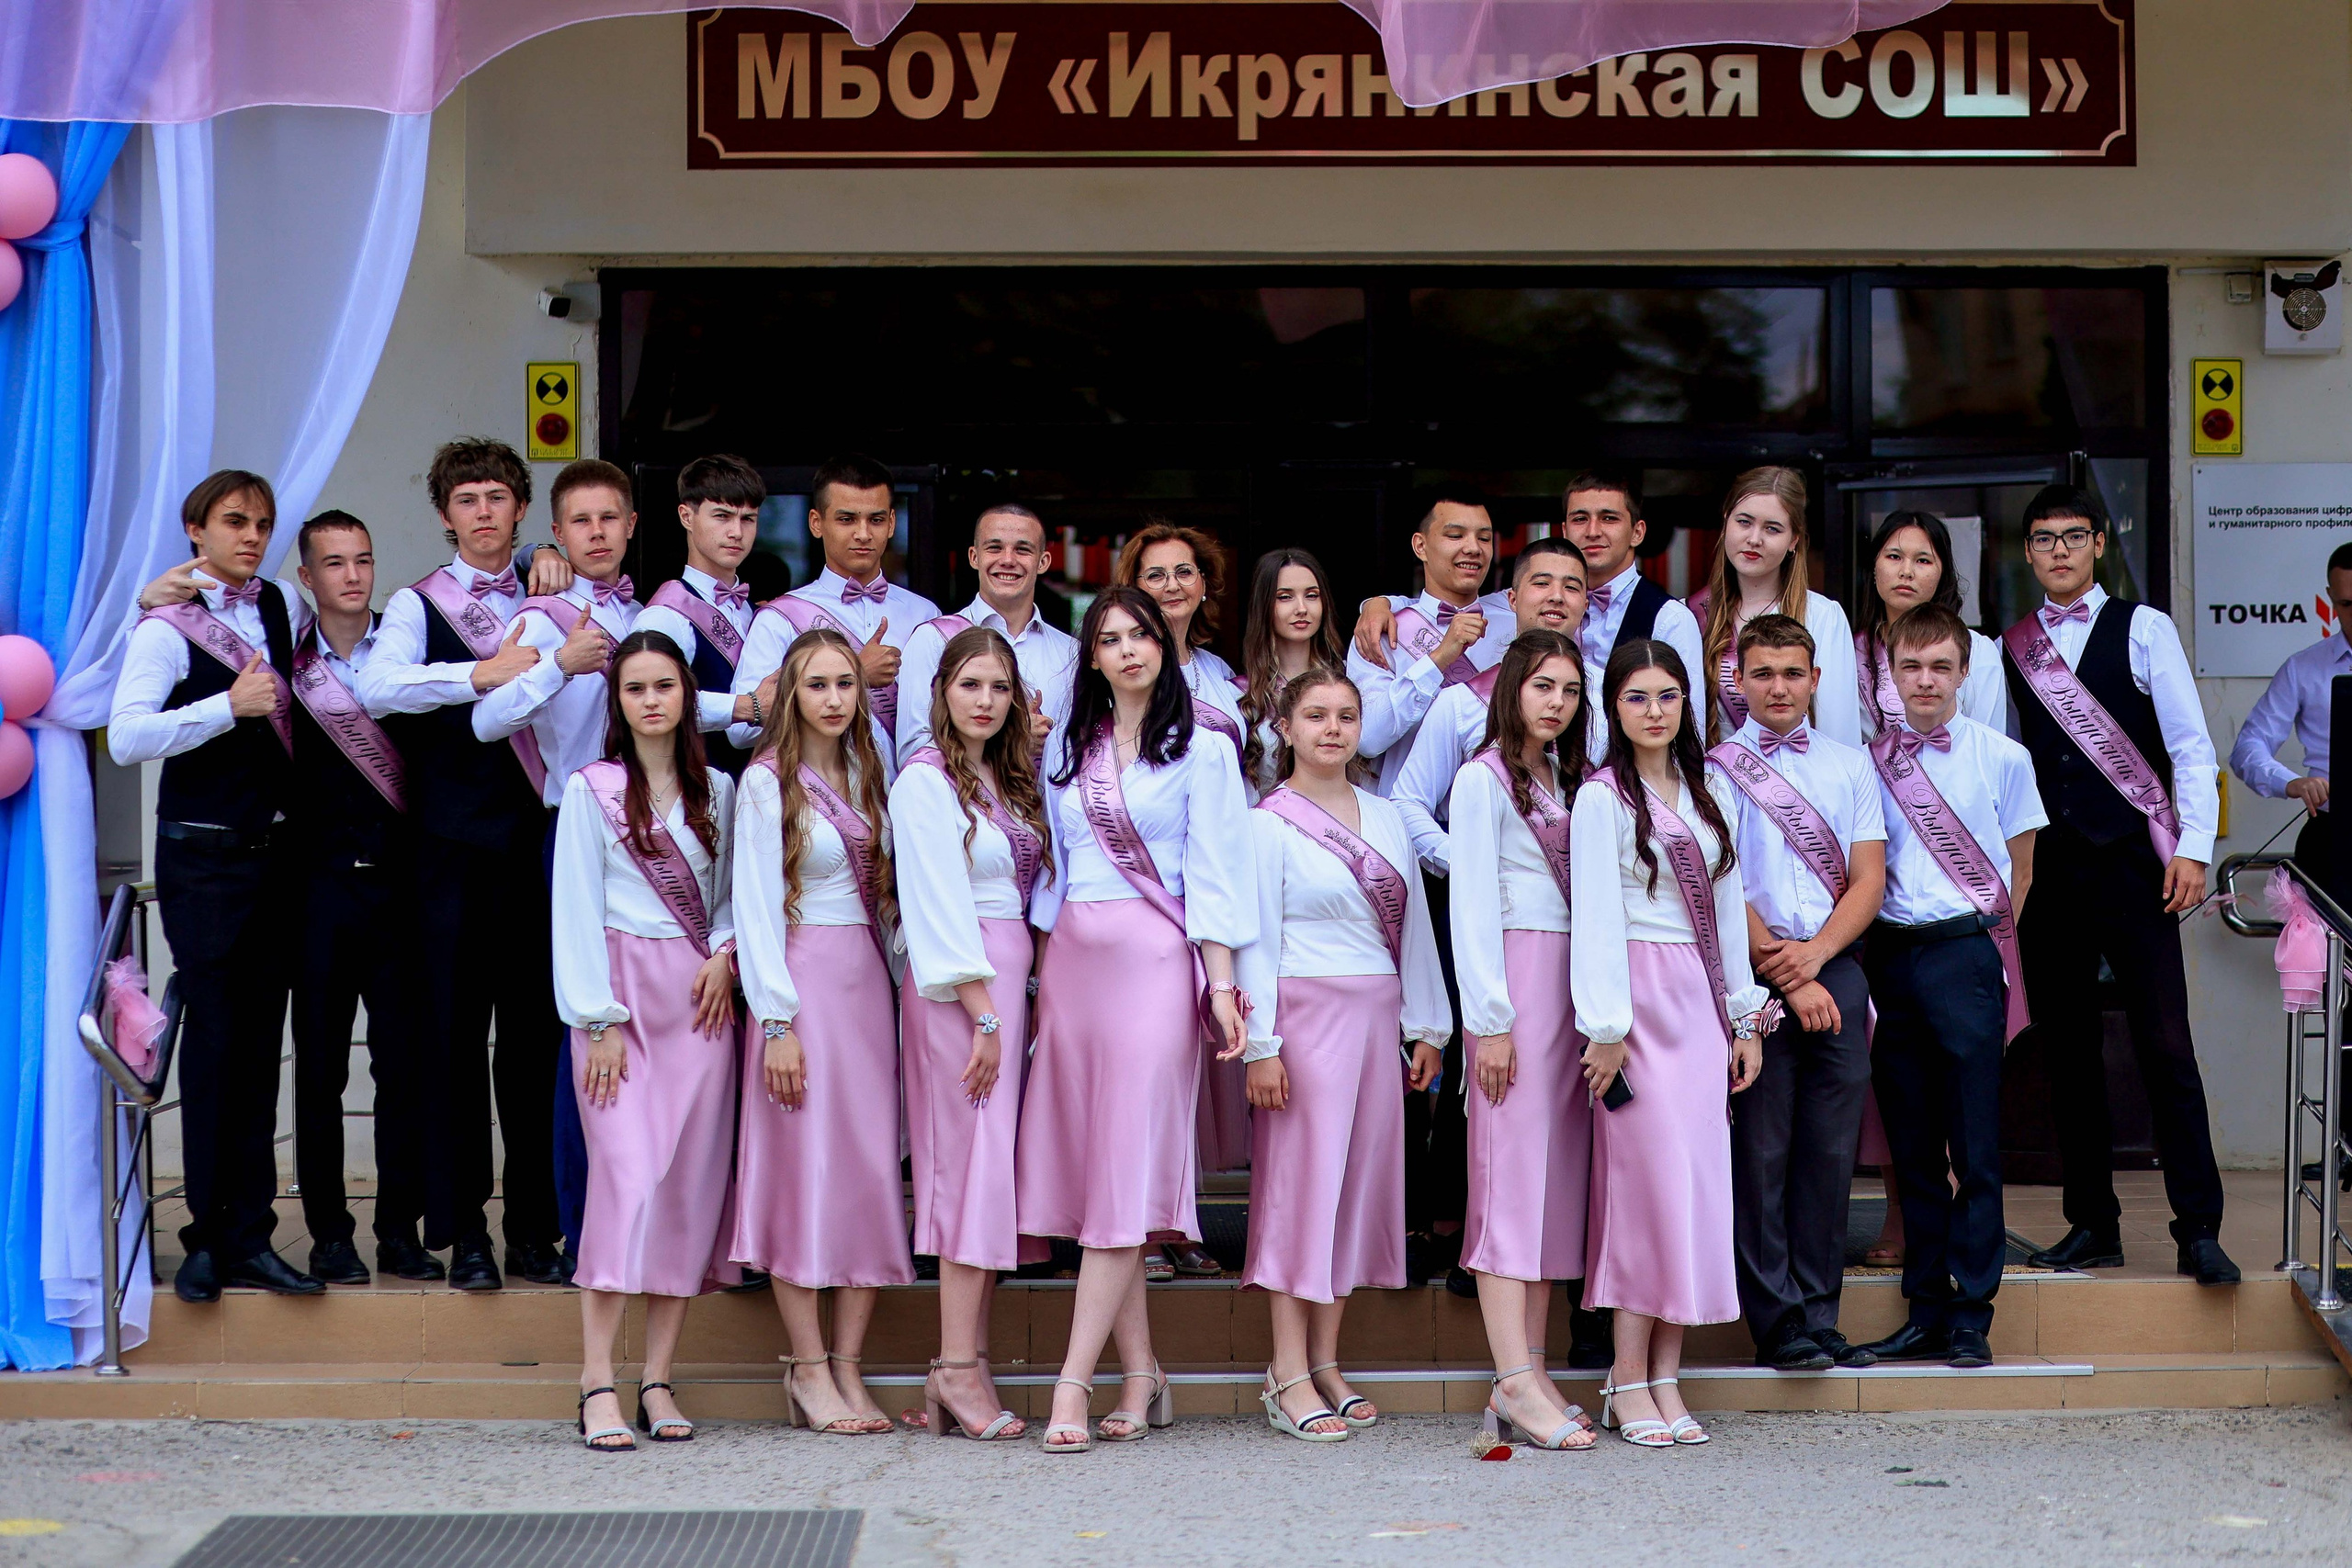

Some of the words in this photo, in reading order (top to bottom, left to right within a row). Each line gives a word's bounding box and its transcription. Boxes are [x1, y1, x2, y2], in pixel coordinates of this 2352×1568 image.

[738, 31, 1017, 119] МБОУ
[1801, 30, 2089, 119] СОШ»
[2208, 506, 2243, 517] Центр
[2245, 505, 2319, 517] образования
[2209, 521, 2215, 529] и
[2219, 520, 2302, 530] гуманитарного
[2305, 518, 2352, 529] профил
[2209, 604, 2307, 625] ТОЧКА
[2044, 670, 2137, 783] Выпускник
[1089, 760, 1137, 872] Выпускни
[1905, 782, 1998, 906] Выпускник
